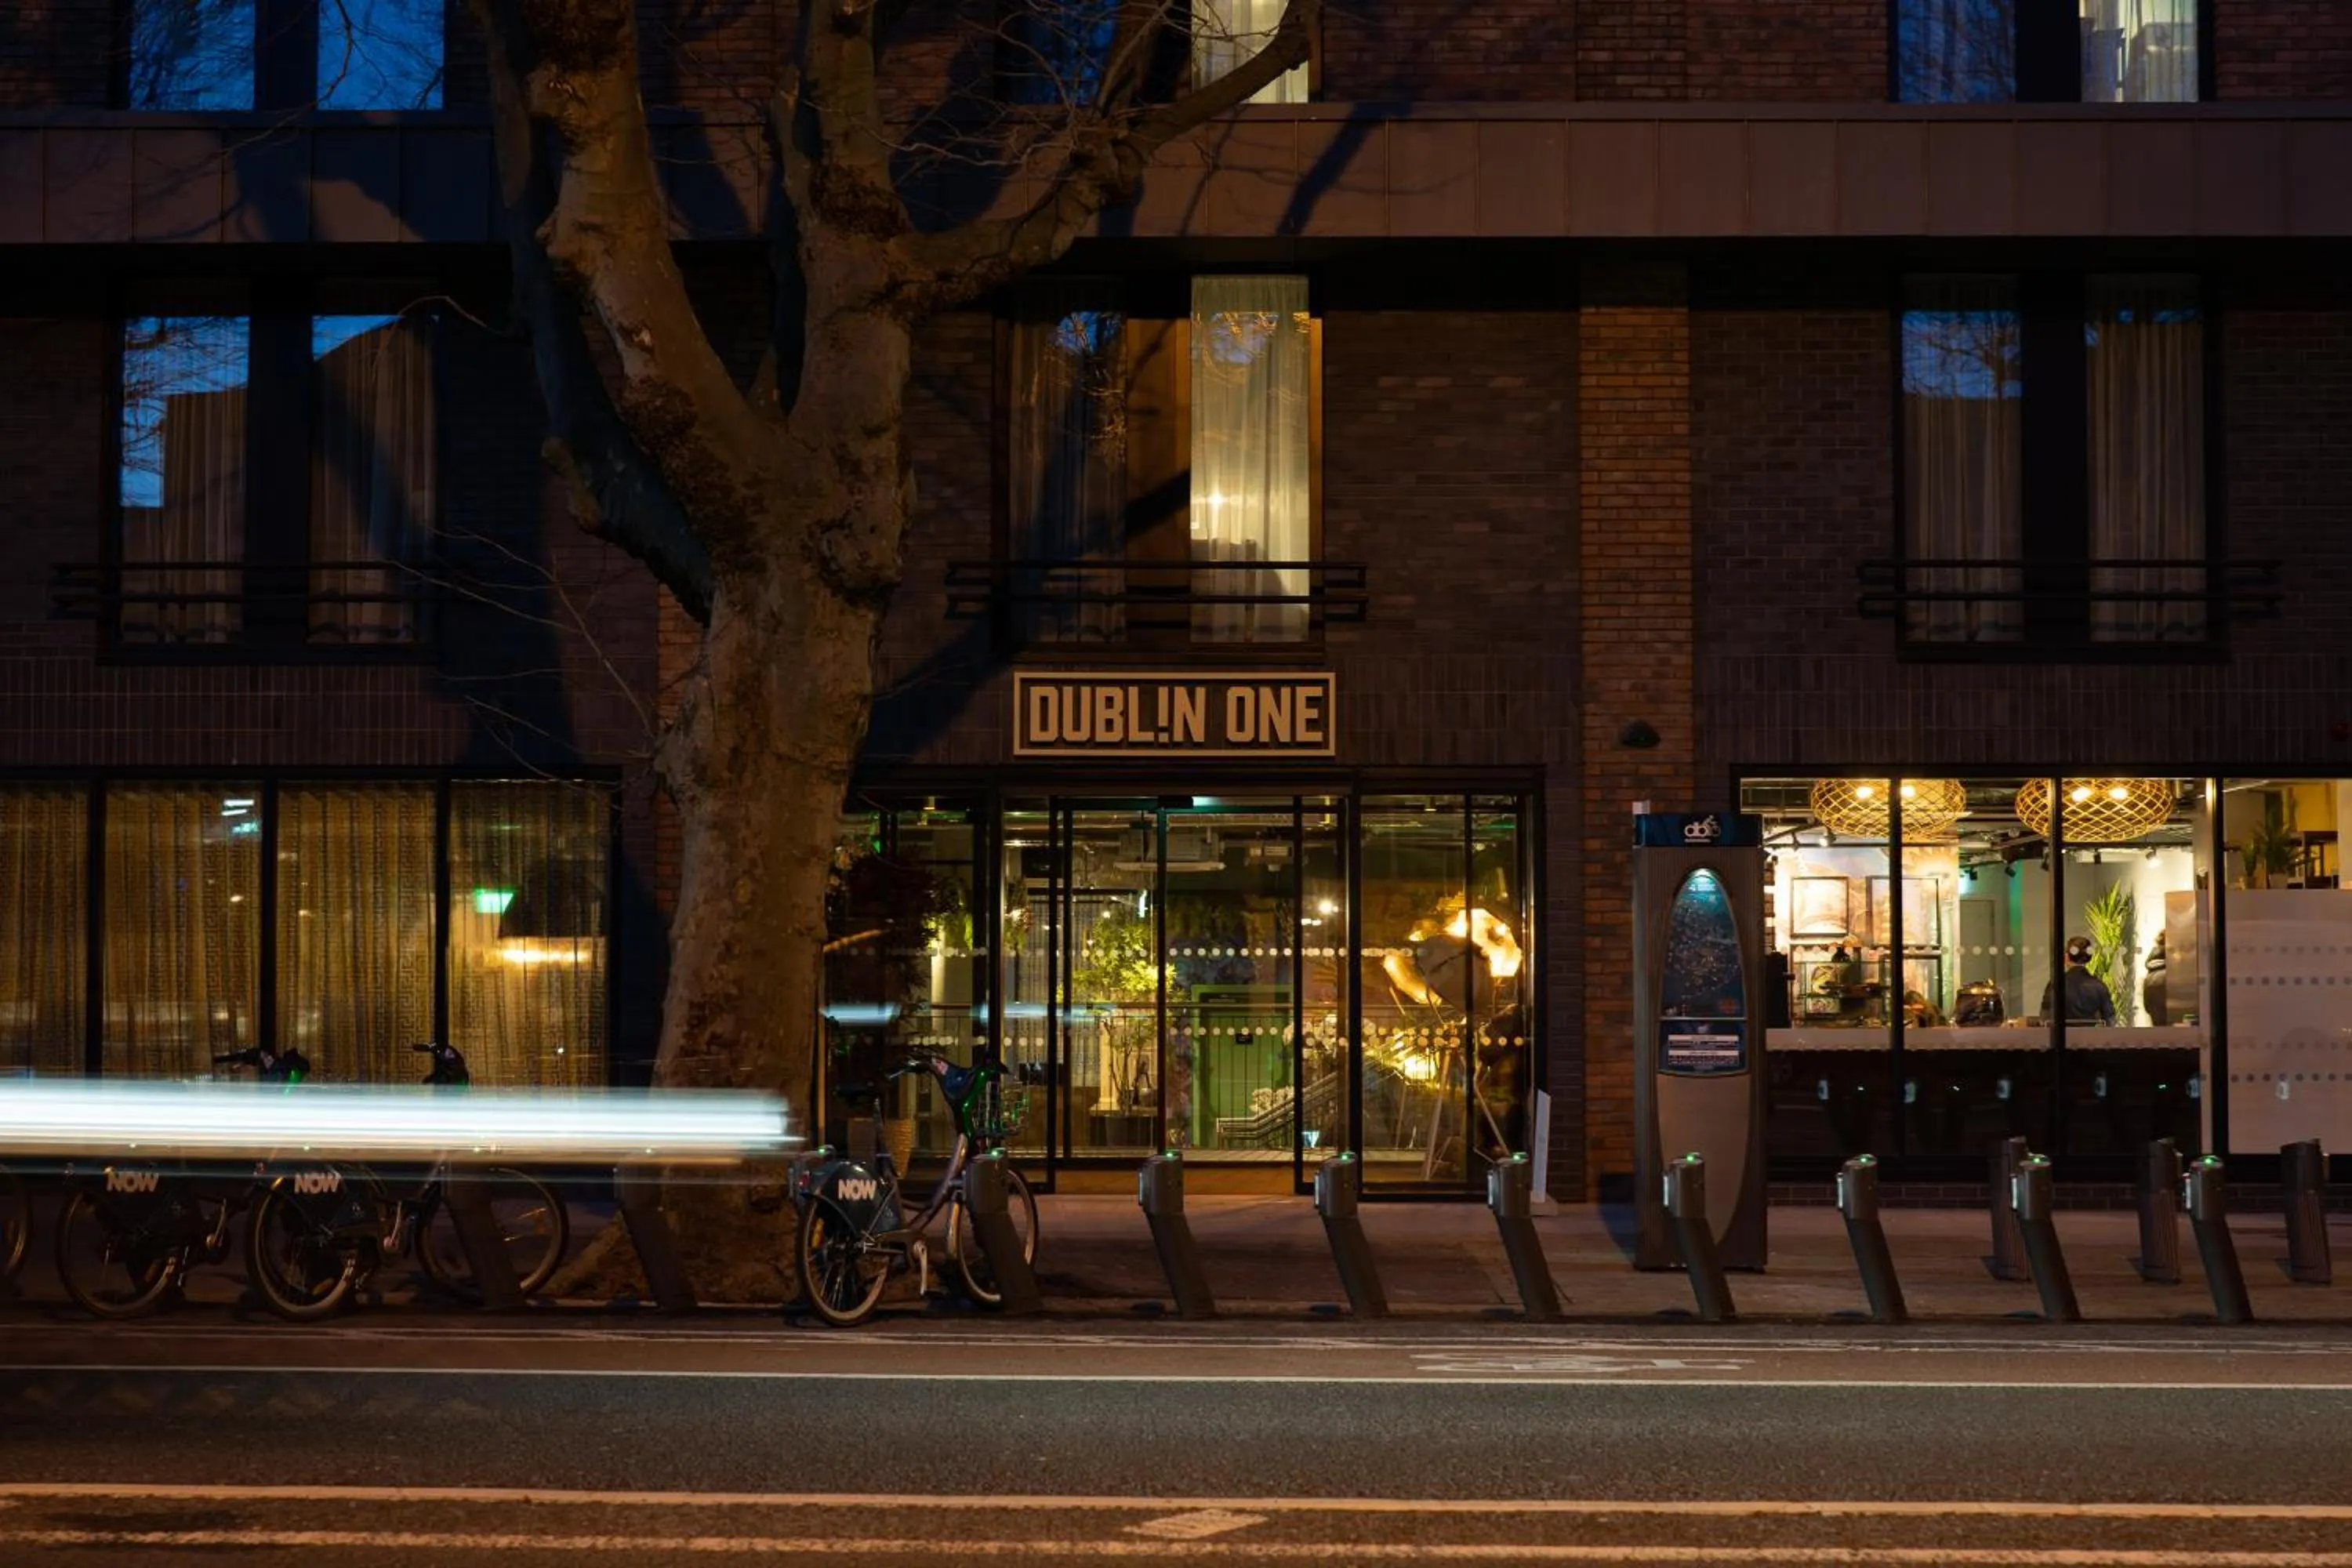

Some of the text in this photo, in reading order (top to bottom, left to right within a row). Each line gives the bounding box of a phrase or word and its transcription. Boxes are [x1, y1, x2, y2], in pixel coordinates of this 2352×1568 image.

[1029, 686, 1323, 743] DUBL!N ONE
[106, 1171, 159, 1192] NOW
[294, 1172, 341, 1194] NOW
[838, 1178, 877, 1201] NOW
